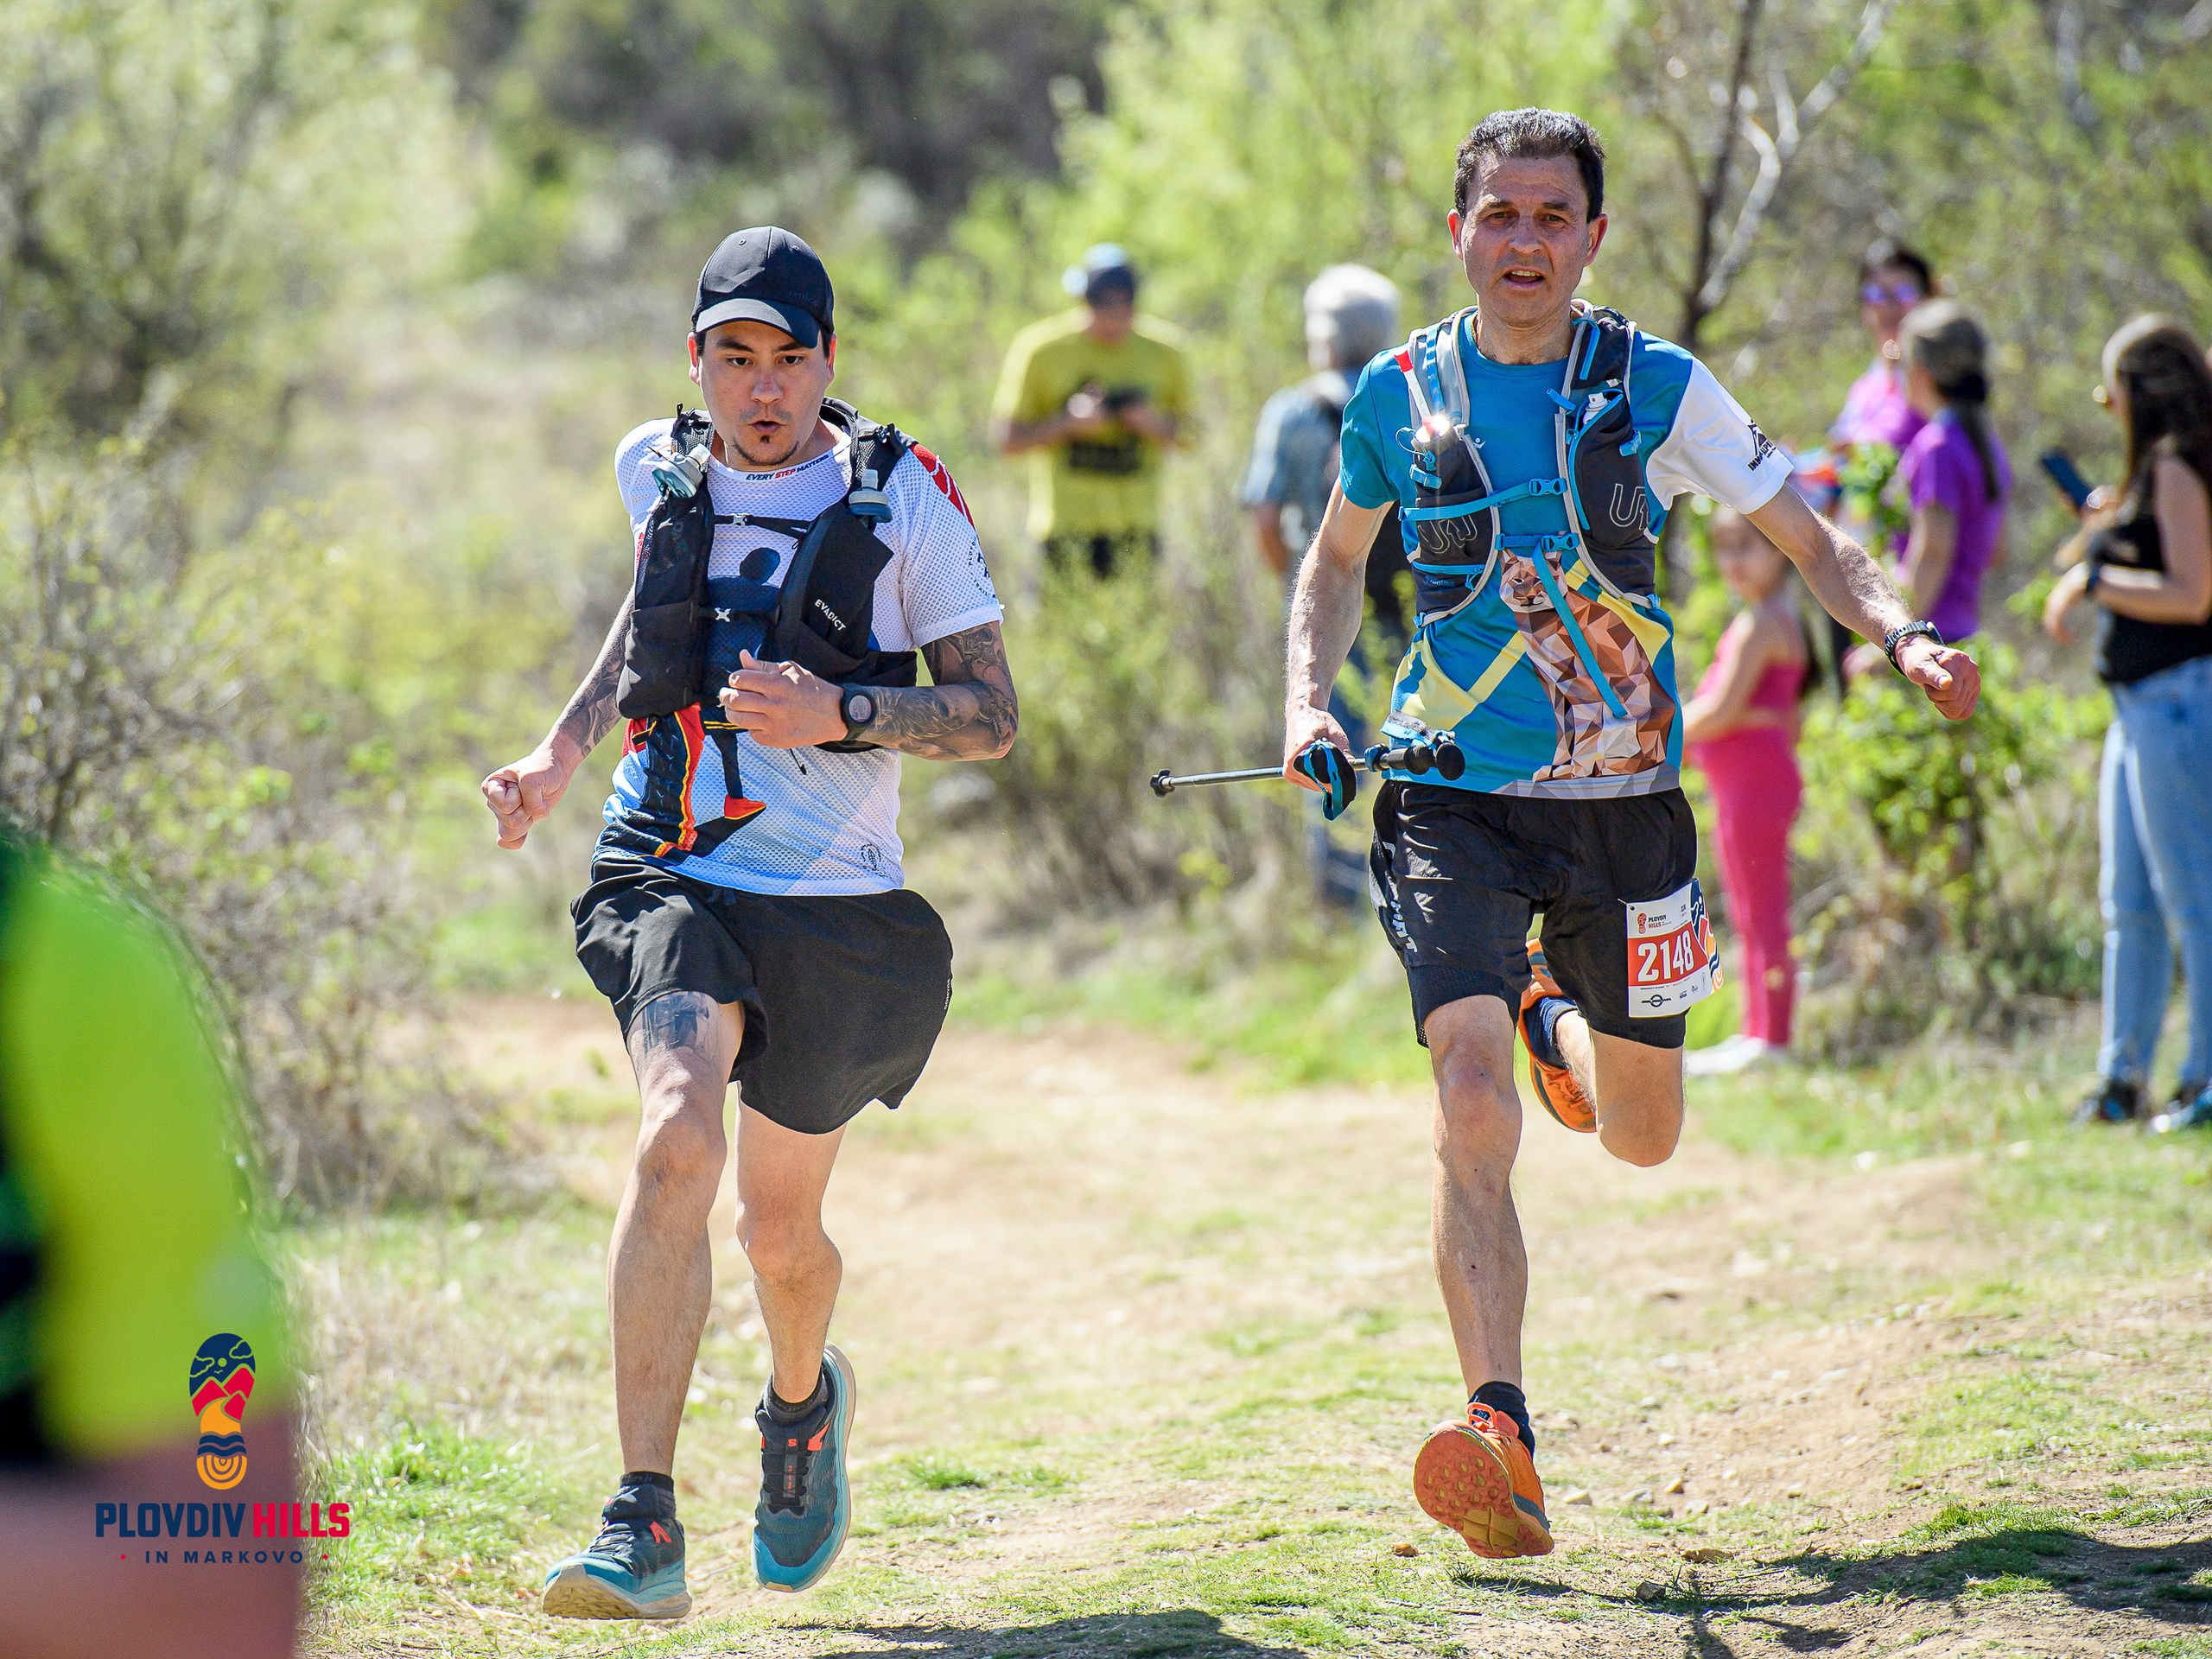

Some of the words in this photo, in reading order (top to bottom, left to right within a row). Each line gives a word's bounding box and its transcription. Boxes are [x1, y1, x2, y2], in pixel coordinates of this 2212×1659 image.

[746, 473, 775, 481] EVERY
[775, 467, 796, 479] STEP
[814, 599, 846, 631] EVADICT
[1637, 930, 1694, 983] 2148
